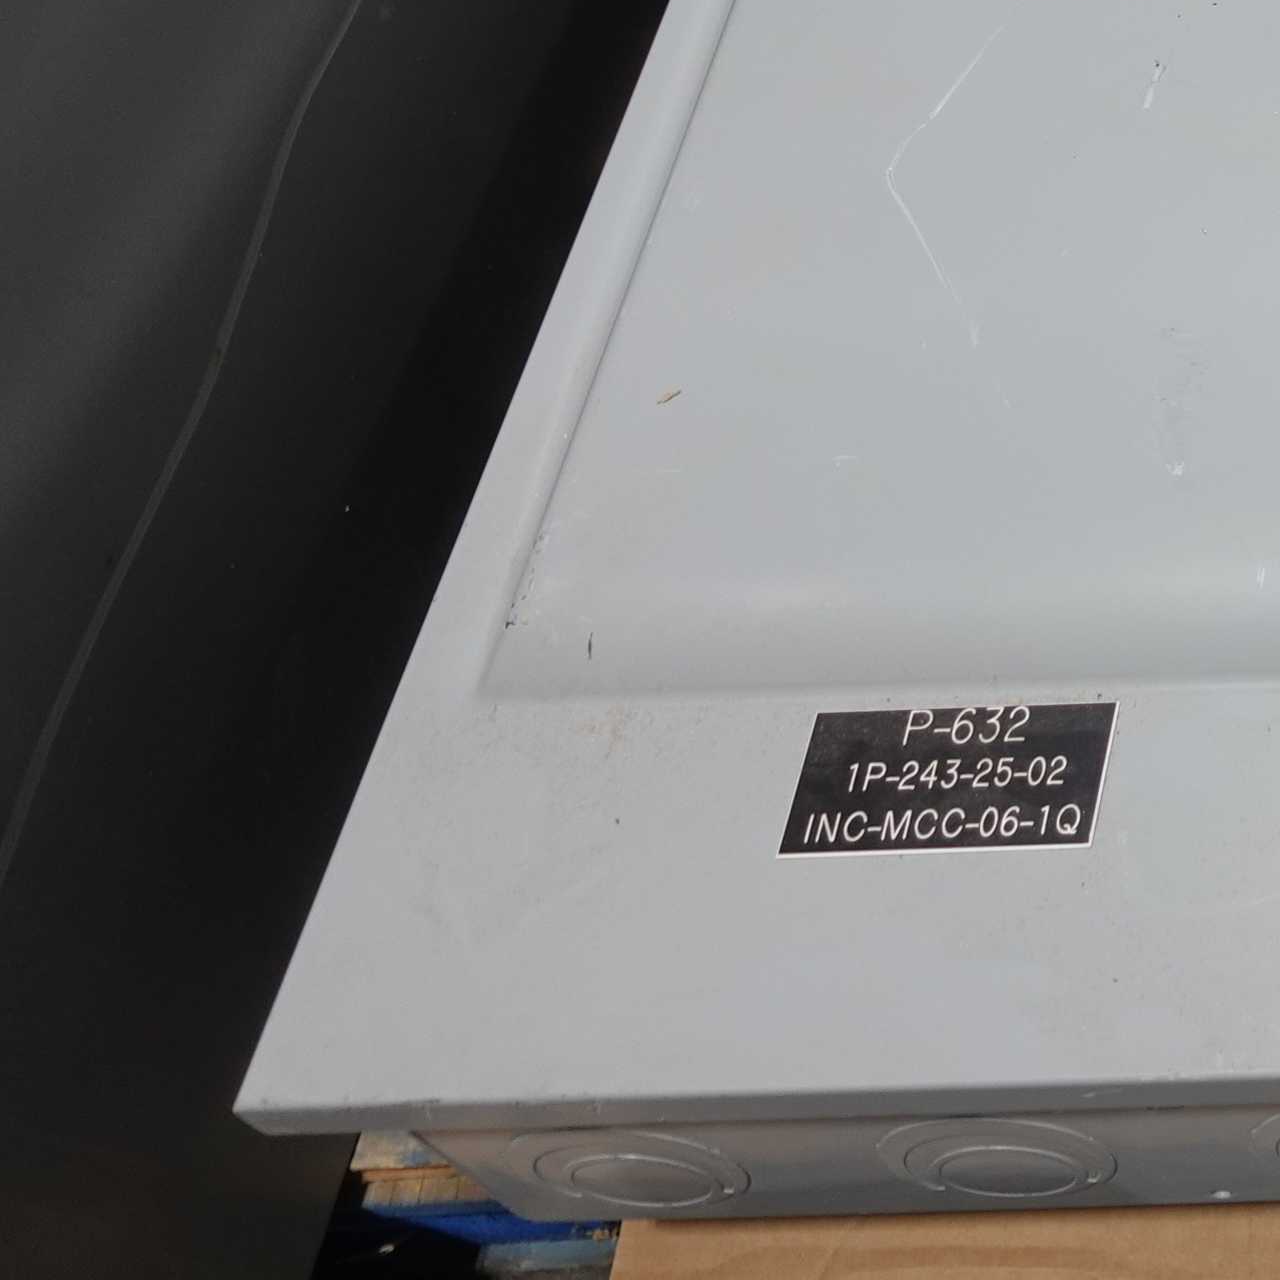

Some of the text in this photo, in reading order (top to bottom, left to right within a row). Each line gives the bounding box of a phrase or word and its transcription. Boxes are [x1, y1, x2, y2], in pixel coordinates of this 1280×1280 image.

[902, 705, 1031, 747] P-632
[848, 755, 1068, 794] 1P-243-25-02
[803, 803, 1082, 844] INC-MCC-06-1Q
